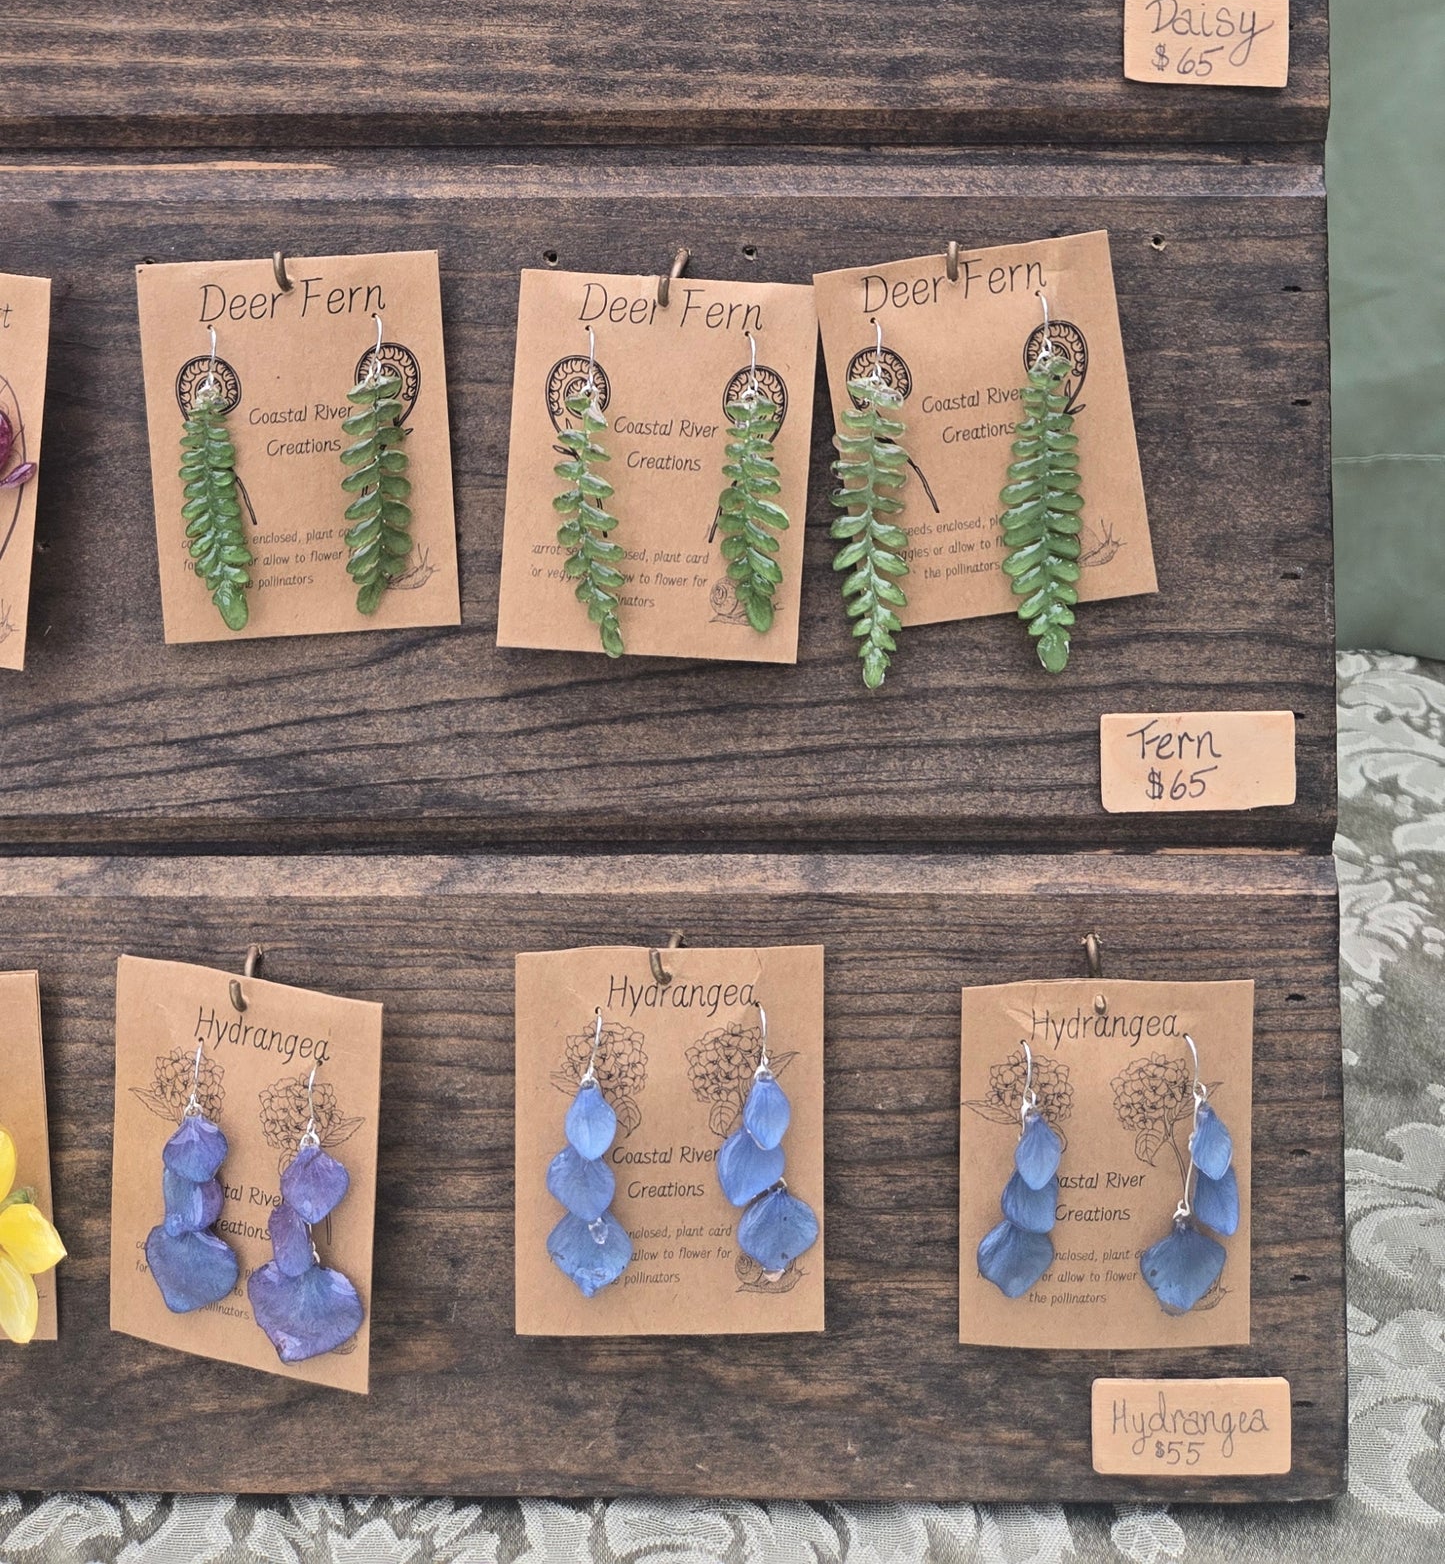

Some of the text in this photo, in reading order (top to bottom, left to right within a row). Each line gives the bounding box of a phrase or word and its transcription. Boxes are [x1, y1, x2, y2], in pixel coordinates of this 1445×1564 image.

[1150, 43, 1225, 77] $65
[862, 256, 1048, 314] Deer Fern
[199, 276, 386, 324] Deer Fern
[680, 288, 763, 331] Fern
[922, 390, 980, 414] Coastal
[249, 403, 354, 425] Coastal River
[614, 415, 720, 437] Coastal River
[942, 421, 1016, 444] Creations
[266, 438, 342, 457] Creations
[626, 450, 702, 472] Creations
[936, 516, 985, 533] enclosed,
[252, 532, 301, 545] enclosed,
[306, 528, 333, 544] plant
[933, 545, 943, 556] or
[949, 540, 975, 555] allow
[980, 539, 991, 551] to
[262, 554, 290, 566] allow
[295, 551, 306, 563] to
[310, 549, 344, 562] flower
[653, 551, 681, 564] plant
[685, 551, 710, 565] card
[639, 572, 650, 584] to
[654, 572, 688, 586] flower
[692, 574, 708, 587] for
[924, 561, 1000, 580] the pollinators
[258, 574, 314, 590] pollinators
[1126, 718, 1223, 760] Fern
[1145, 765, 1219, 802] $65
[607, 974, 757, 1017] Hydrangea
[194, 1005, 330, 1066] Hydrangea
[1031, 1008, 1179, 1049] Hydrangea
[612, 1145, 719, 1164] Coastal River
[627, 1180, 705, 1199] Creations
[1057, 1171, 1146, 1189] astal River
[1055, 1204, 1131, 1222] Creations
[213, 1218, 272, 1241] reations
[676, 1224, 703, 1239] plant
[708, 1224, 732, 1237] card
[631, 1246, 732, 1261] allow to flower for
[1055, 1249, 1098, 1263] nclosed,
[1102, 1249, 1130, 1263] plant
[624, 1271, 681, 1286] pollinators
[1041, 1269, 1137, 1283] or allow to flower
[1029, 1291, 1107, 1307] the pollinators
[1111, 1389, 1270, 1458] Hydrangea
[1155, 1439, 1206, 1467] $55
